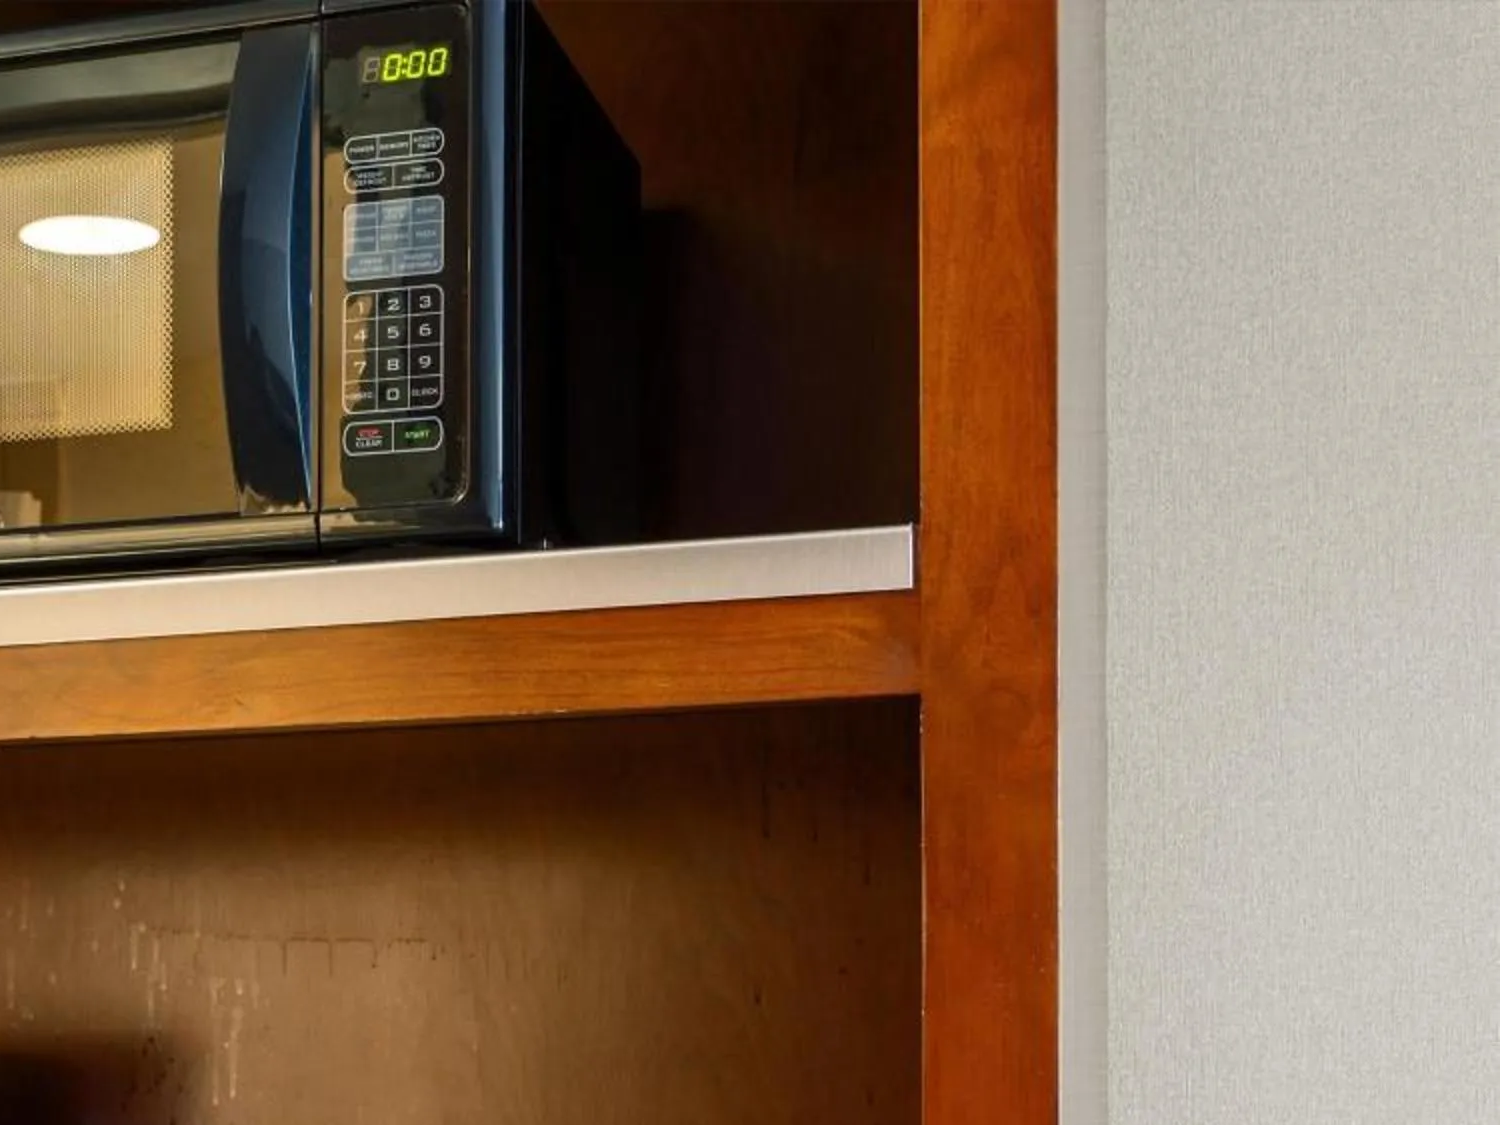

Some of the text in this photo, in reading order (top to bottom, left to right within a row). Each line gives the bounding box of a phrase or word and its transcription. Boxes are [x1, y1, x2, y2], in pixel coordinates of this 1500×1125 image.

[382, 48, 447, 82] 0:00
[357, 301, 365, 315] 1
[387, 299, 400, 311] 2
[419, 295, 432, 309] 3
[353, 328, 368, 343] 4
[387, 327, 400, 340] 5
[419, 323, 432, 337] 6
[353, 361, 367, 375] 7
[386, 358, 400, 371] 8
[419, 355, 432, 369] 9
[386, 387, 400, 401] 0
